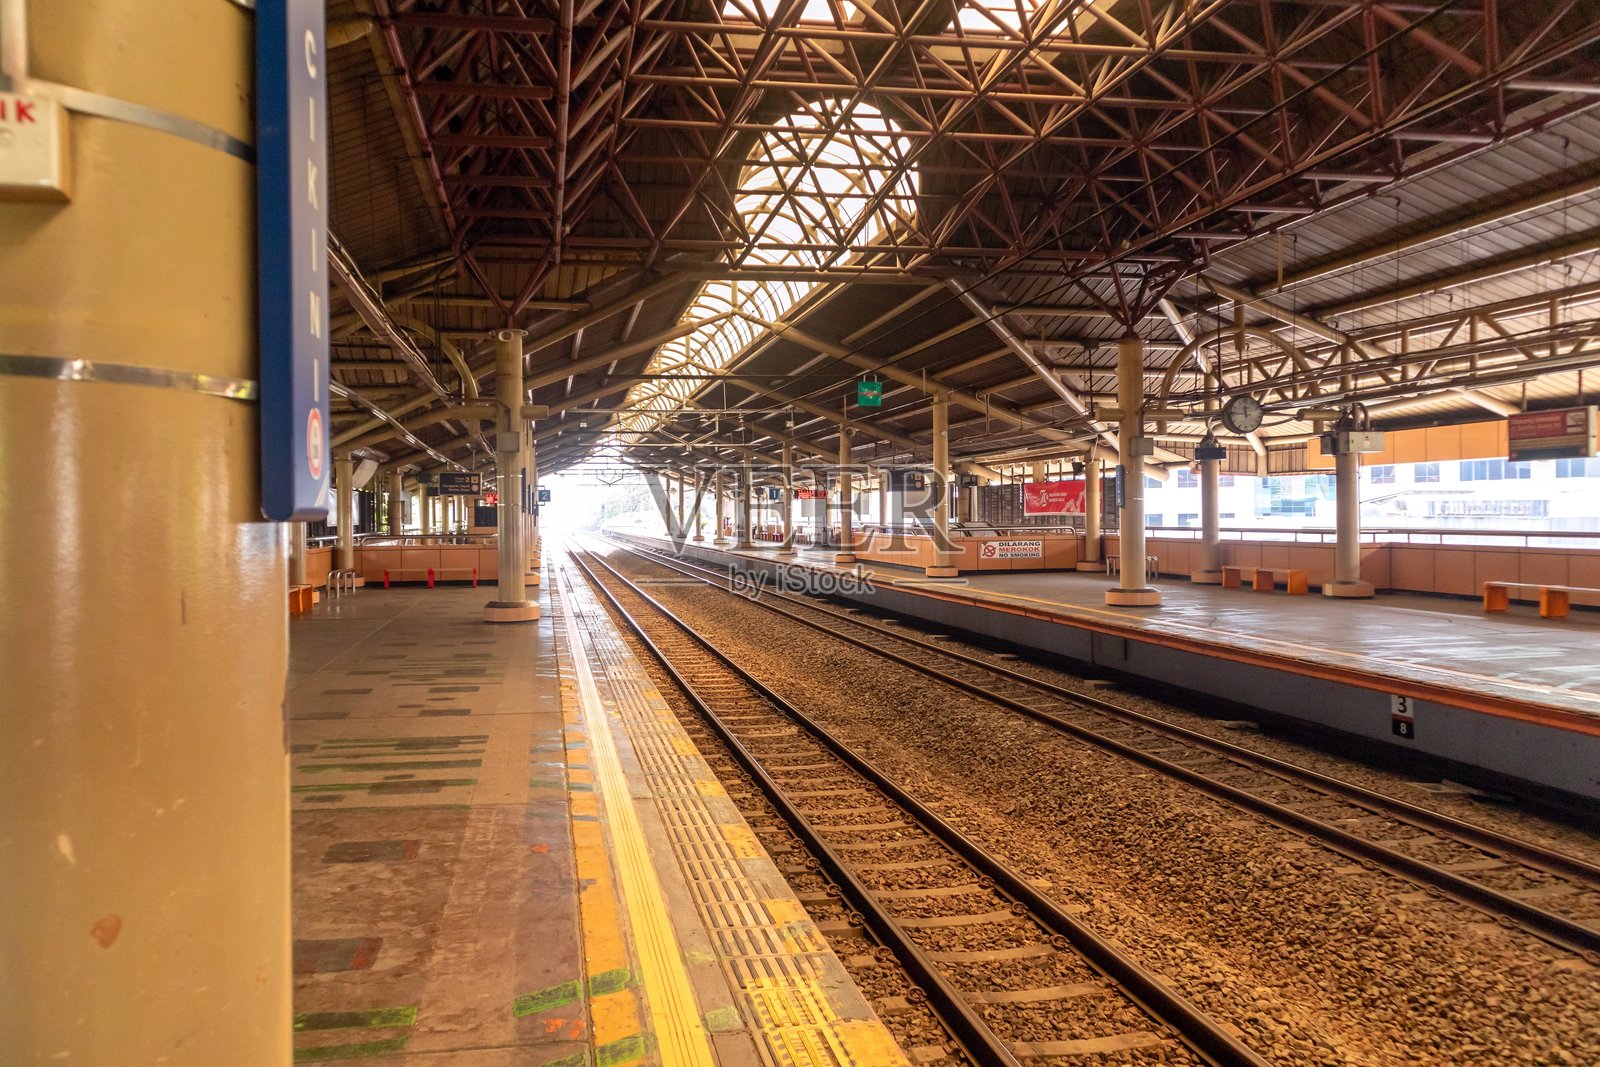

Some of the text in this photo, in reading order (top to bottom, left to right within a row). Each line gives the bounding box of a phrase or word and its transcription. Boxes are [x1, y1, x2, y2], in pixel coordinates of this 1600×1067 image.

[304, 29, 322, 403] CIKINI
[541, 491, 548, 500] 2
[1398, 696, 1407, 713] 3
[1400, 722, 1407, 734] 8
